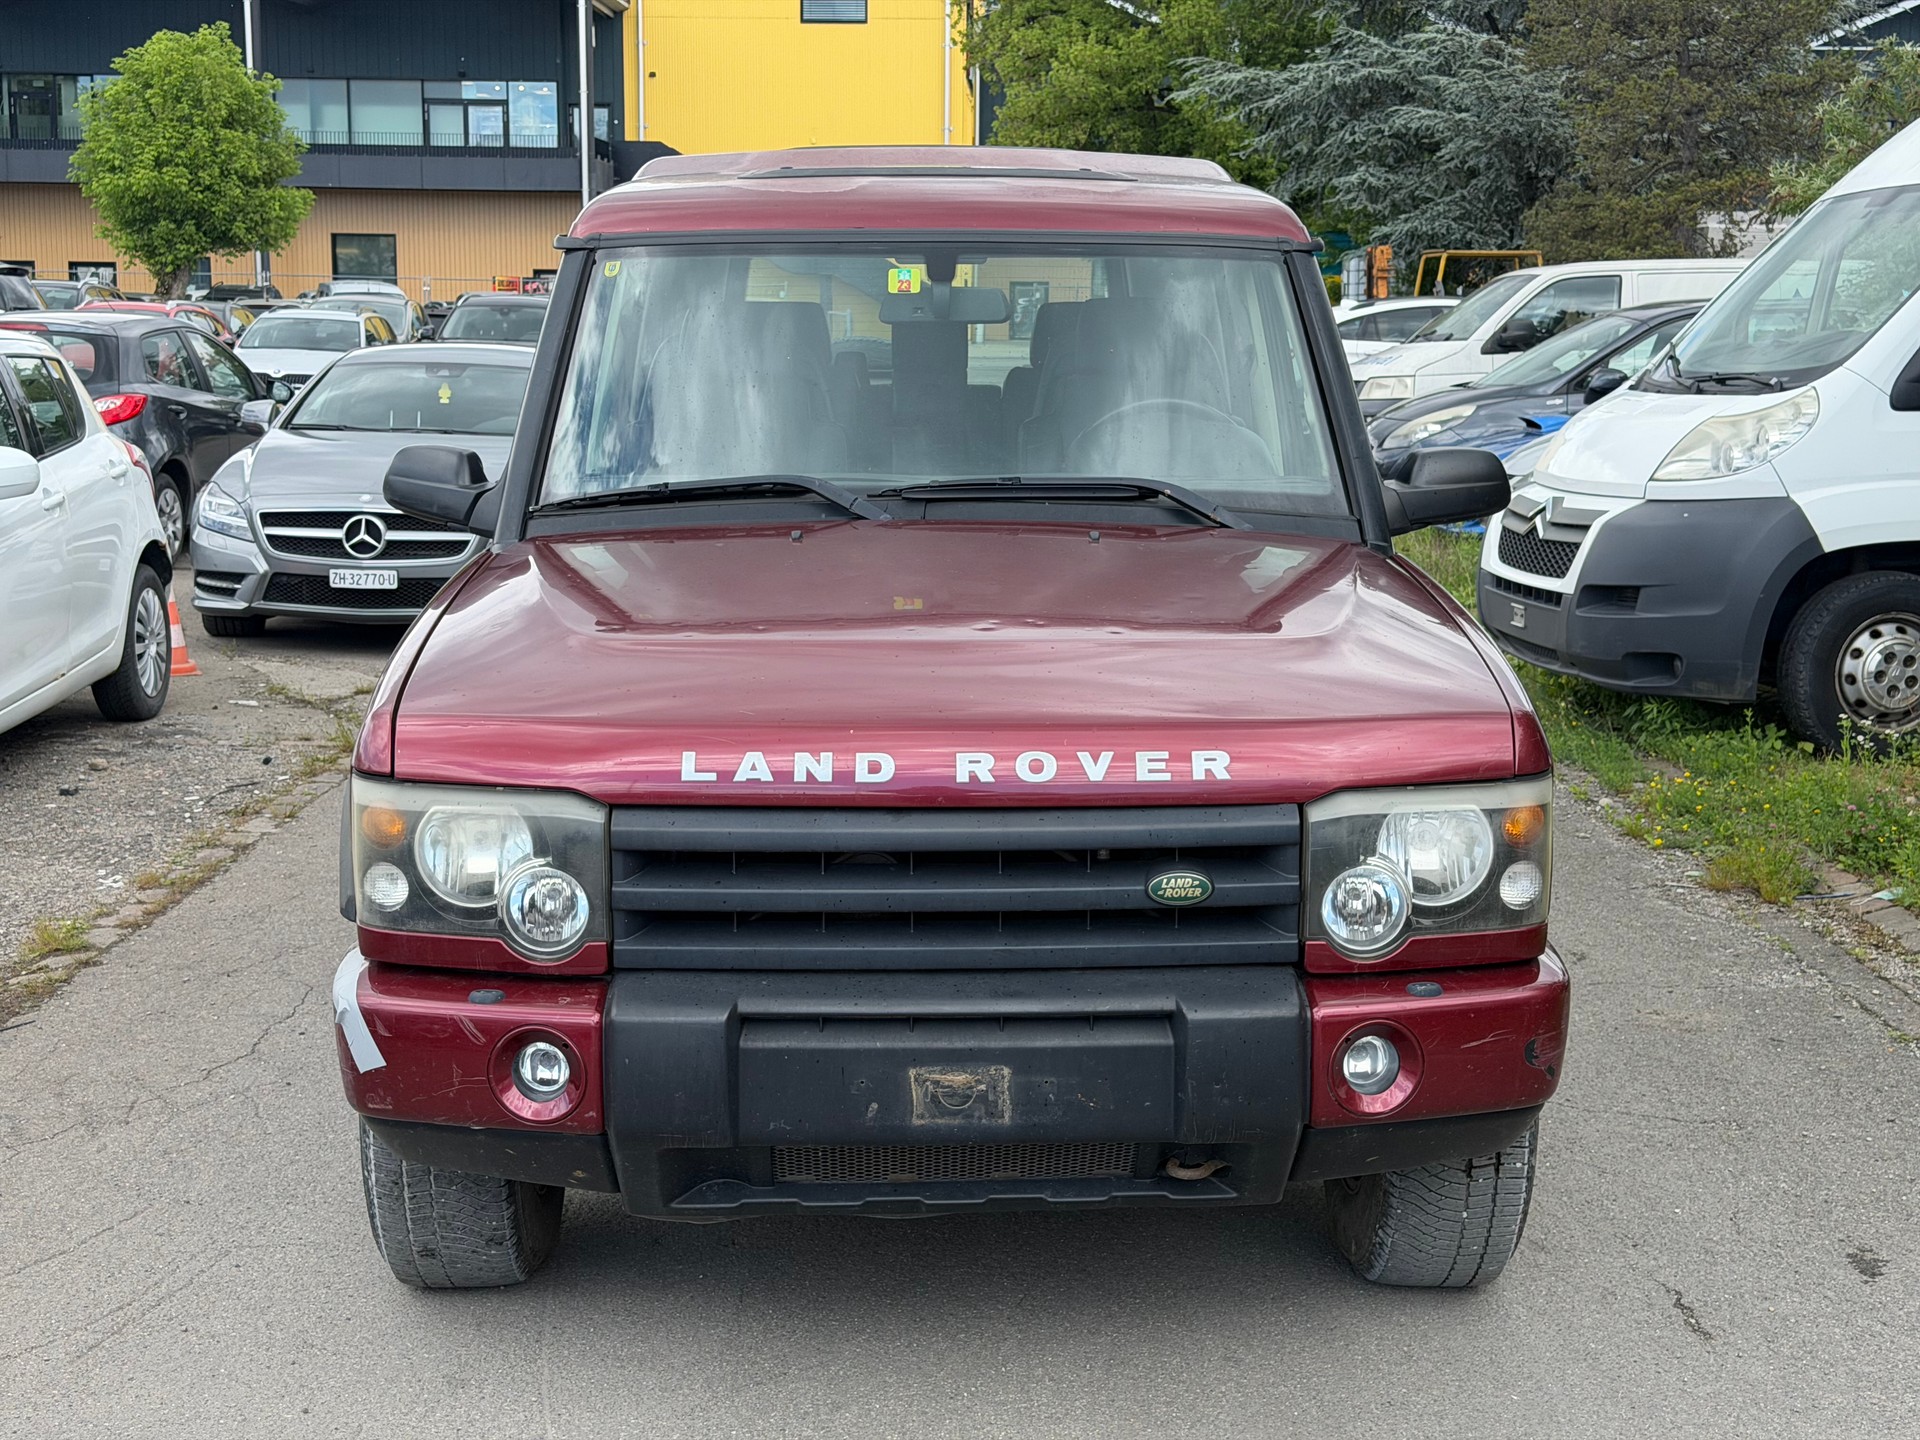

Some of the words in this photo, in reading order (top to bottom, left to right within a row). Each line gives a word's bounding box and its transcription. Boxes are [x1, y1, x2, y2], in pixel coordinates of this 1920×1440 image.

[897, 279, 912, 291] 23
[681, 751, 896, 783] LAND
[955, 750, 1232, 783] ROVER
[1161, 878, 1193, 888] LAND
[1164, 887, 1202, 898] ROVER
